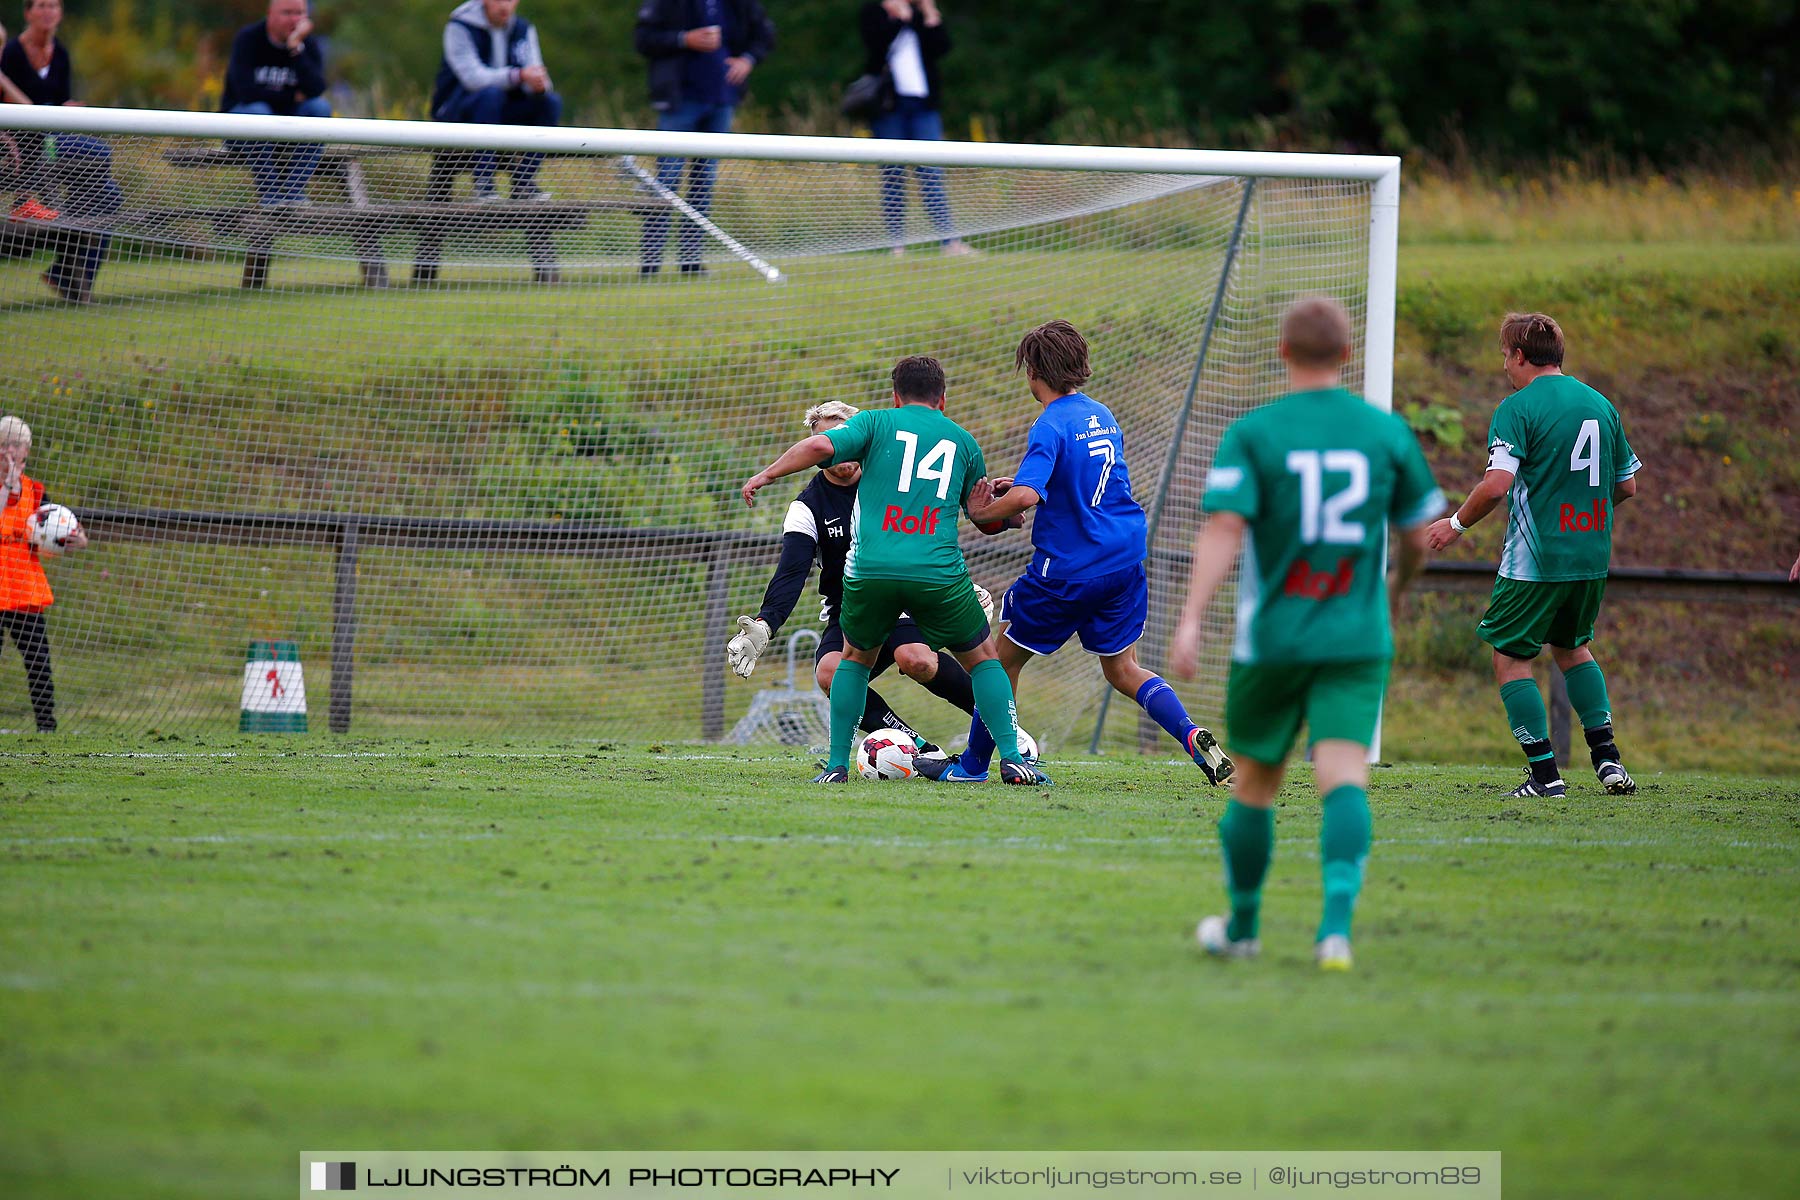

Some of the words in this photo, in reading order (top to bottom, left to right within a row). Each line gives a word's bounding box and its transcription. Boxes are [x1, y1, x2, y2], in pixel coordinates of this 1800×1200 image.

[895, 430, 957, 501] 14
[1087, 438, 1116, 508] 7
[1570, 419, 1600, 487] 4
[881, 504, 941, 536] Rolf
[1286, 448, 1370, 545] 12
[1560, 498, 1608, 533] Rolf
[827, 525, 844, 538] PH
